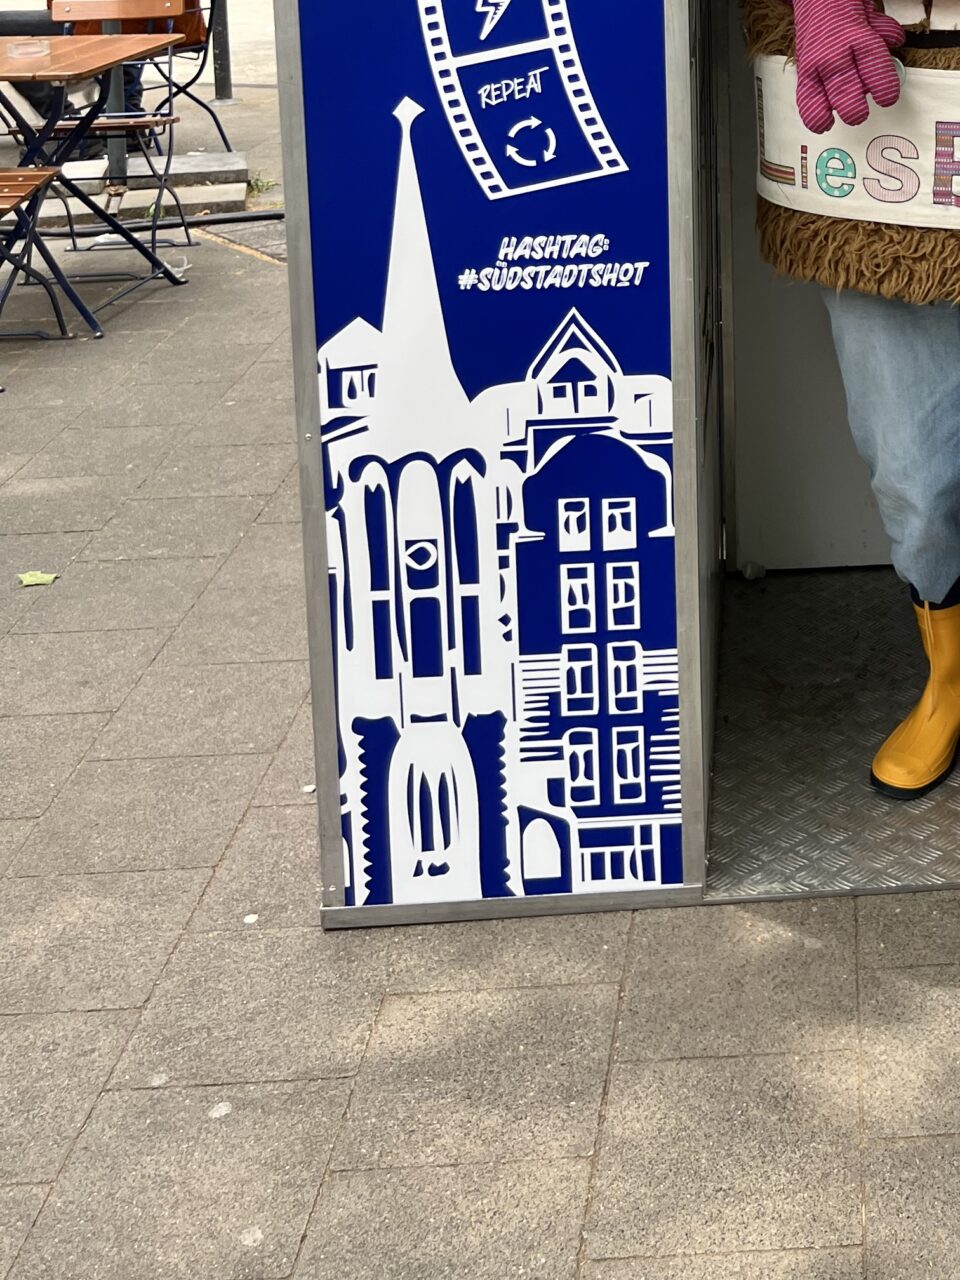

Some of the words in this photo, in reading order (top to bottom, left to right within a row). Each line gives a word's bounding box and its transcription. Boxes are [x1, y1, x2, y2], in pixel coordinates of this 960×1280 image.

[478, 66, 549, 109] REPEAT
[498, 233, 610, 262] HASHTAG:
[458, 261, 650, 291] #SÜDSTADTSHOT
